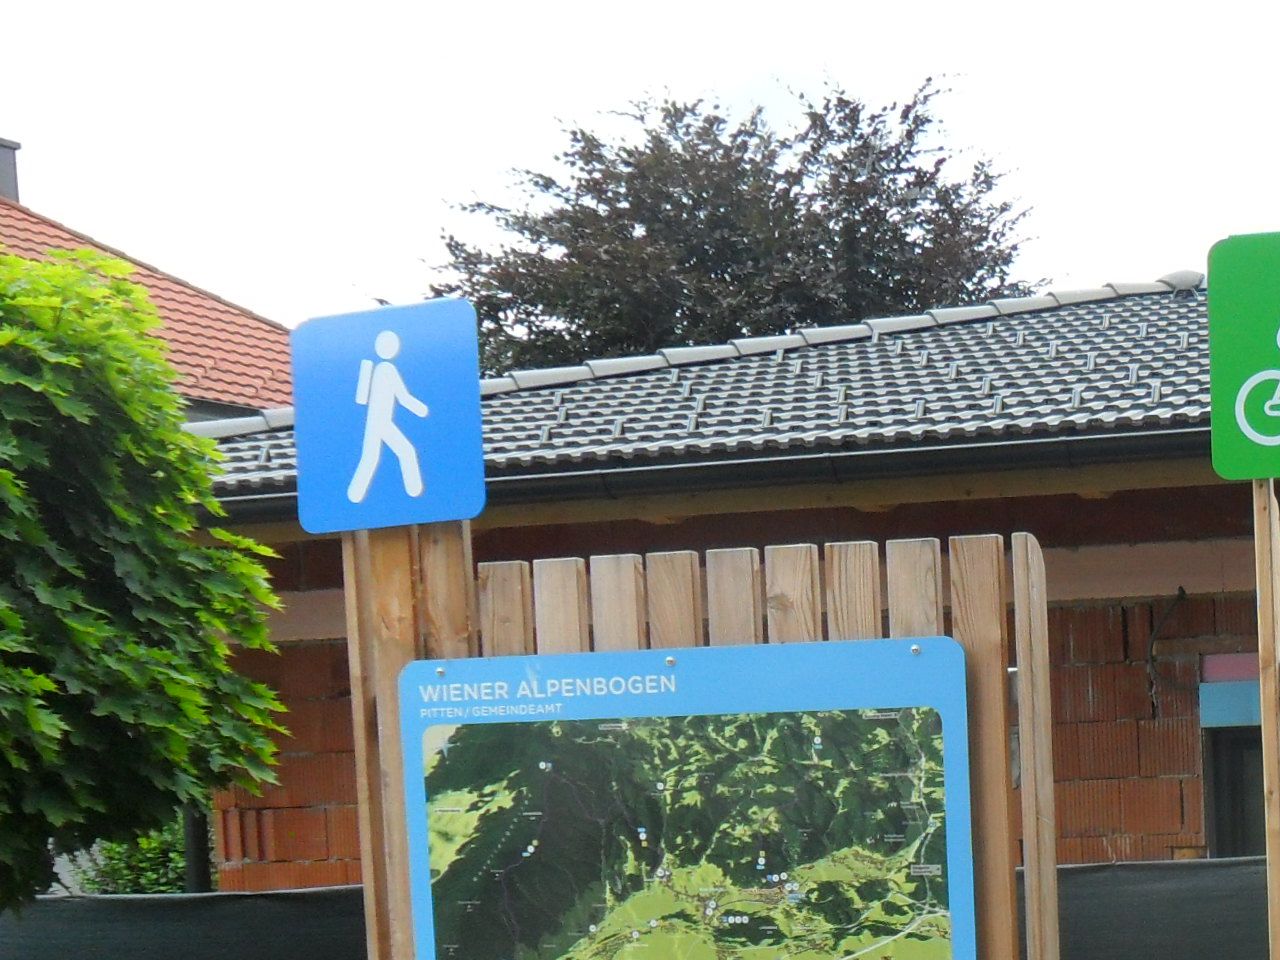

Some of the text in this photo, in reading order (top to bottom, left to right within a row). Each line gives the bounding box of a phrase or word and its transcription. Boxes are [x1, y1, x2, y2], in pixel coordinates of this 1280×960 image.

[418, 674, 676, 703] WIENER ALPENBOGEN
[420, 708, 463, 719] PITTEN
[473, 704, 563, 717] GEMEINDEAMT
